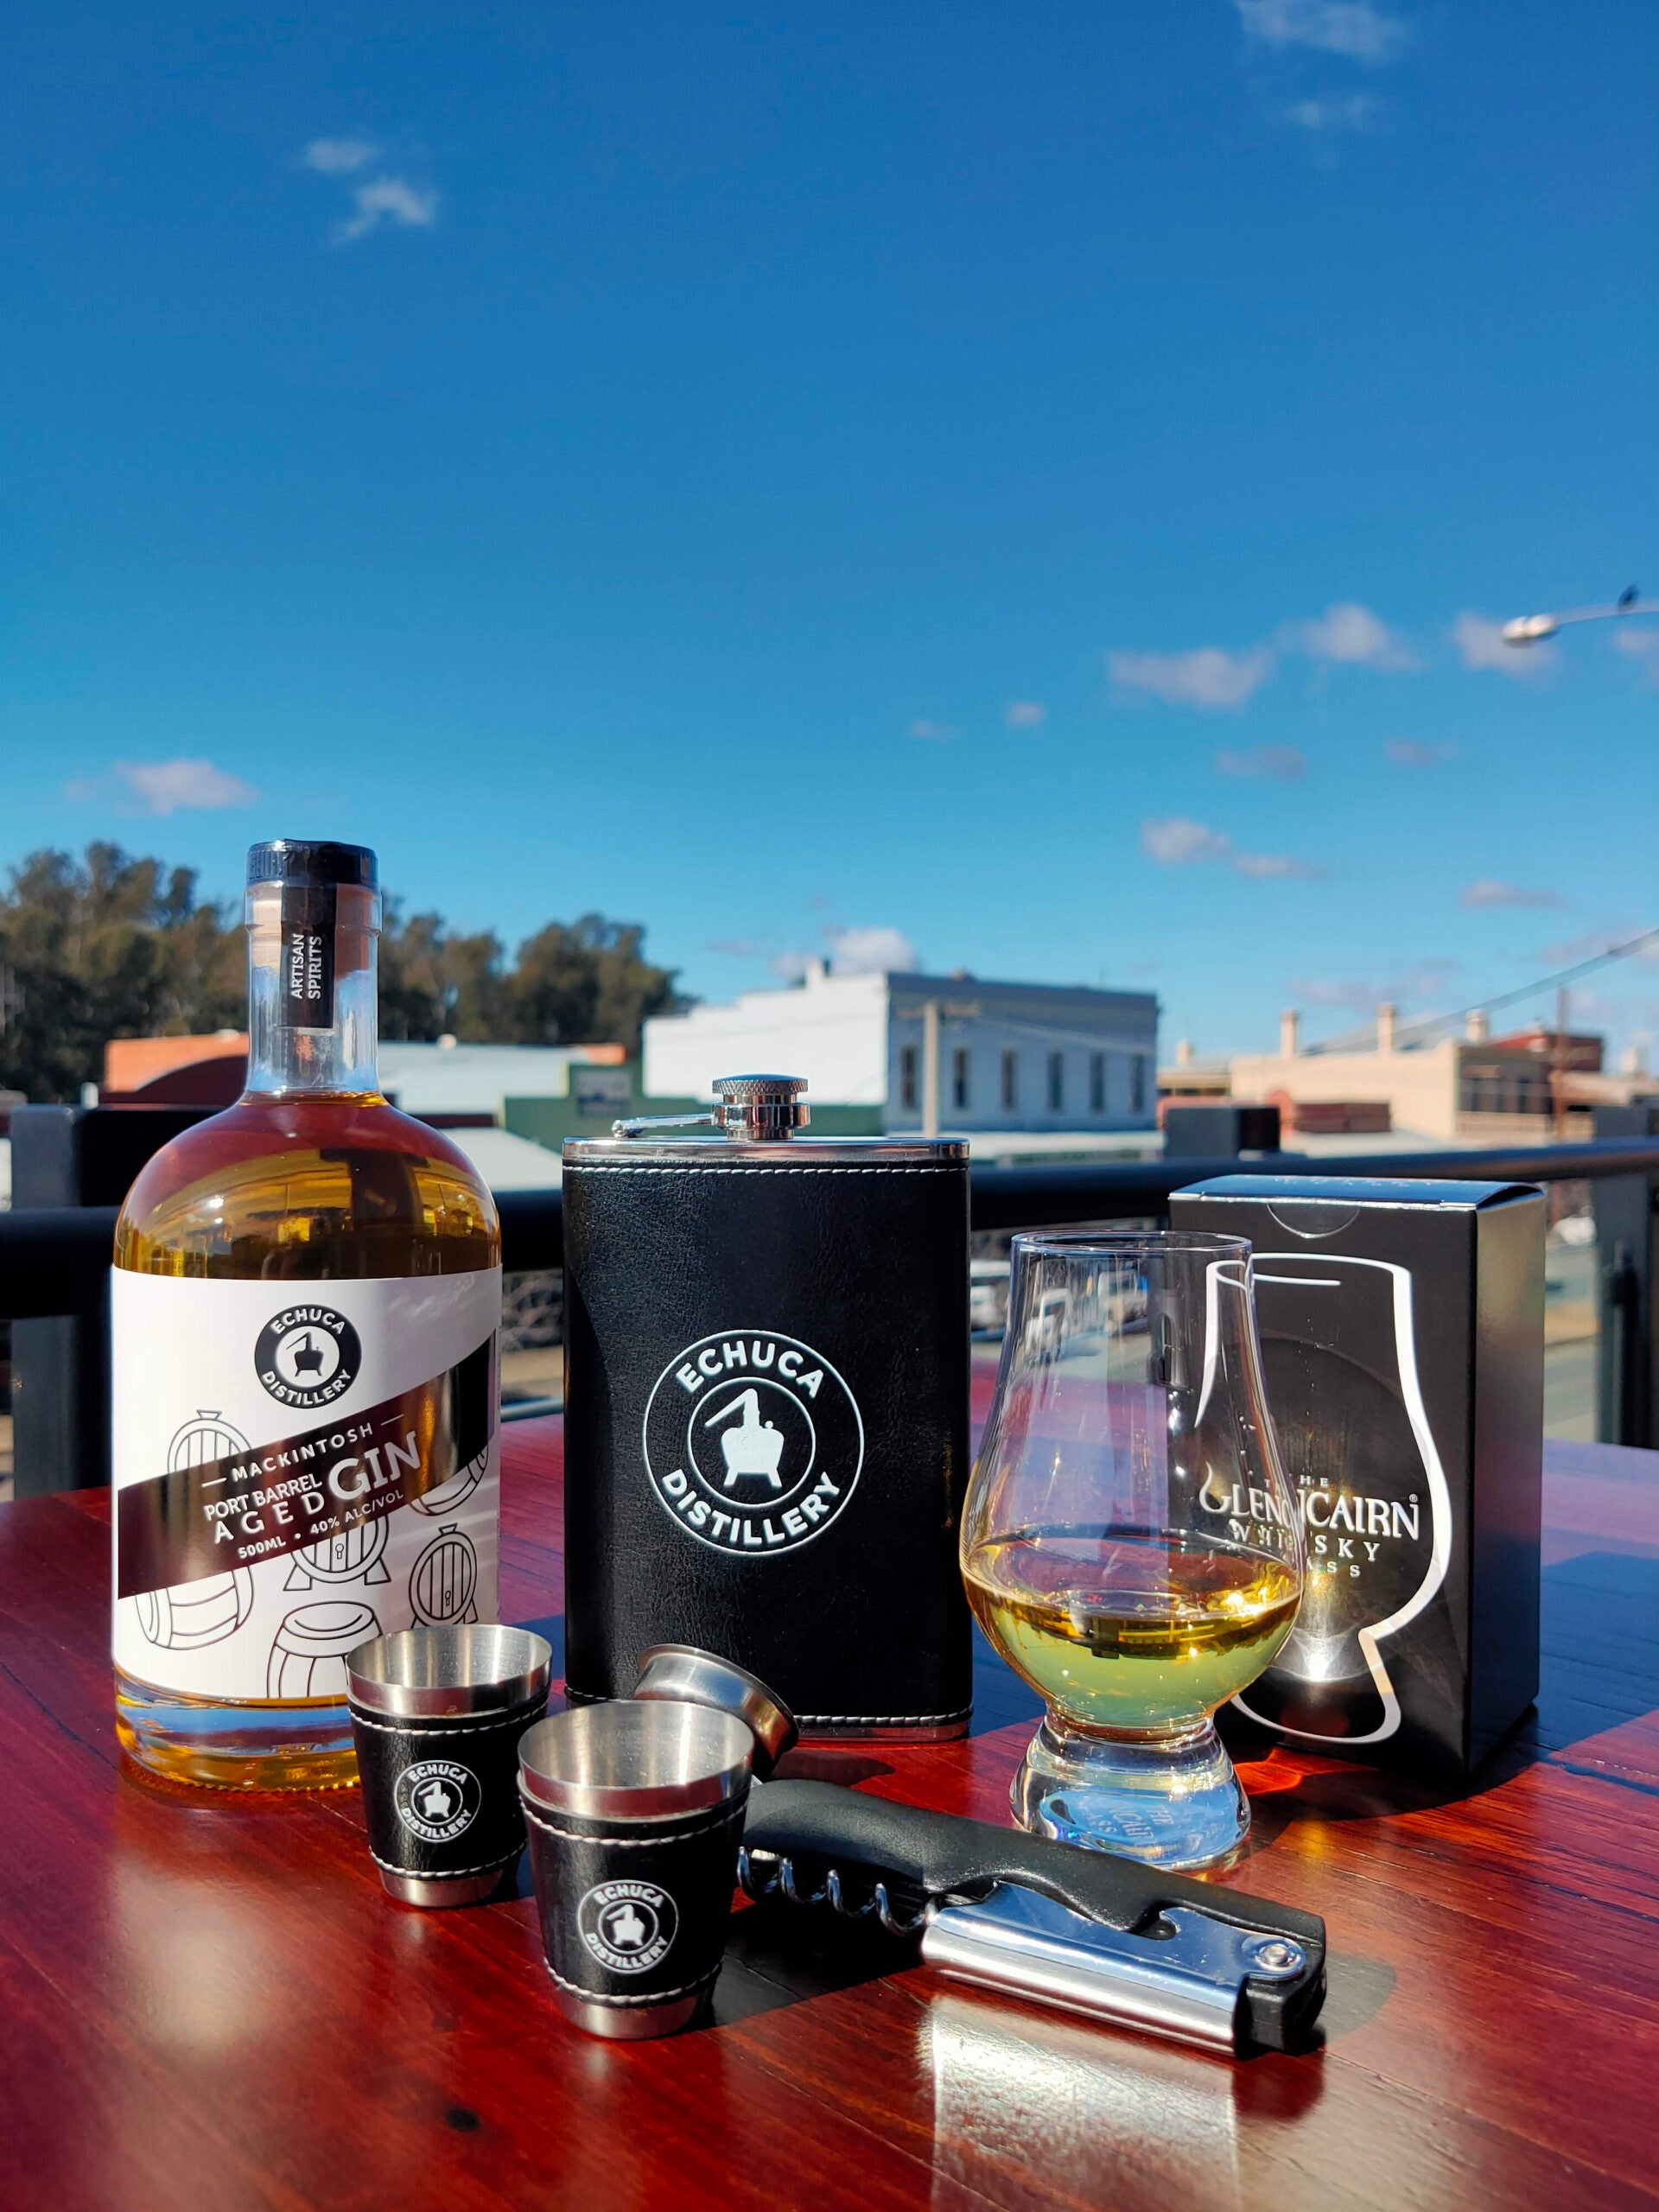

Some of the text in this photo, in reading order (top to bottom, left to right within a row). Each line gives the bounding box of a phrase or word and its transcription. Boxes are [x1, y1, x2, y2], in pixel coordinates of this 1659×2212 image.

[290, 933, 305, 1000] ARTISAN
[308, 936, 322, 1000] SPIRITS
[270, 1307, 346, 1335] ECHUCA
[262, 1369, 352, 1405] DISTILLERY
[676, 1340, 824, 1398] ECHUCA
[231, 1422, 374, 1483] MACKINTOSH
[328, 1430, 422, 1501] GIN
[204, 1473, 323, 1522] PORT BARREL
[213, 1491, 326, 1545] AGED
[238, 1489, 405, 1560] 500ML 40% ALC/VOL
[662, 1469, 841, 1544] DISTILLERY
[406, 1764, 468, 1785] ECHUCA
[401, 1808, 472, 1839] DISTILLERY
[593, 1885, 664, 1909] ECHUCA
[585, 1932, 668, 1969] DISTILLERY
